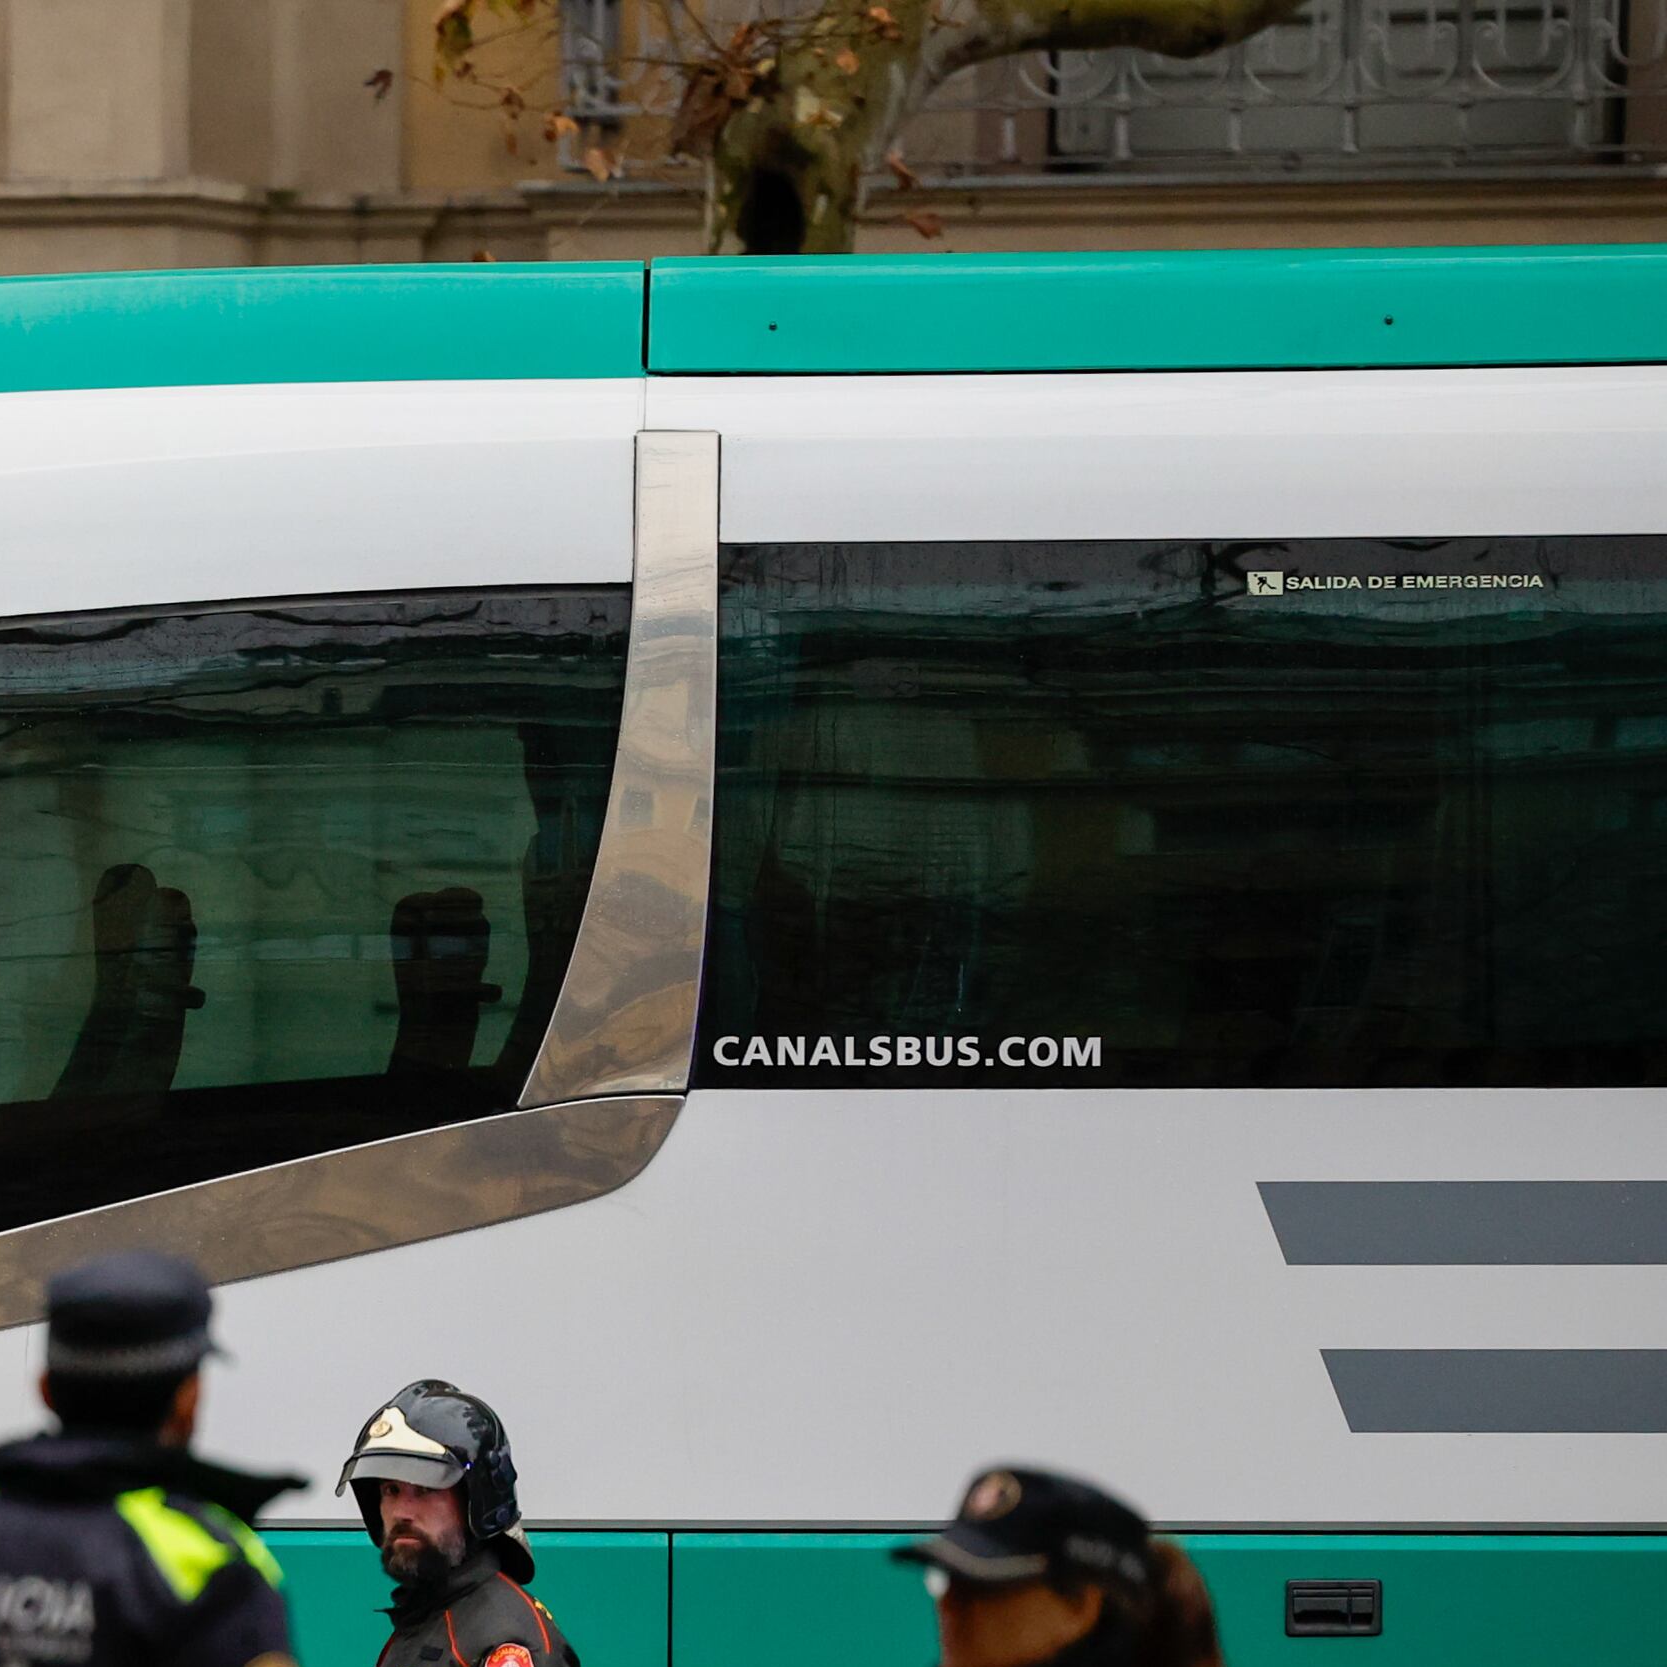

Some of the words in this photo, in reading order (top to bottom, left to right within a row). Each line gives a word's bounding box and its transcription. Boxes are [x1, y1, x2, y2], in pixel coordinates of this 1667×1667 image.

[1285, 576, 1362, 590] SALIDA
[1368, 576, 1397, 589] DE
[1402, 575, 1545, 589] EMERGENCIA
[712, 1035, 1102, 1067] CANALSBUS.COM
